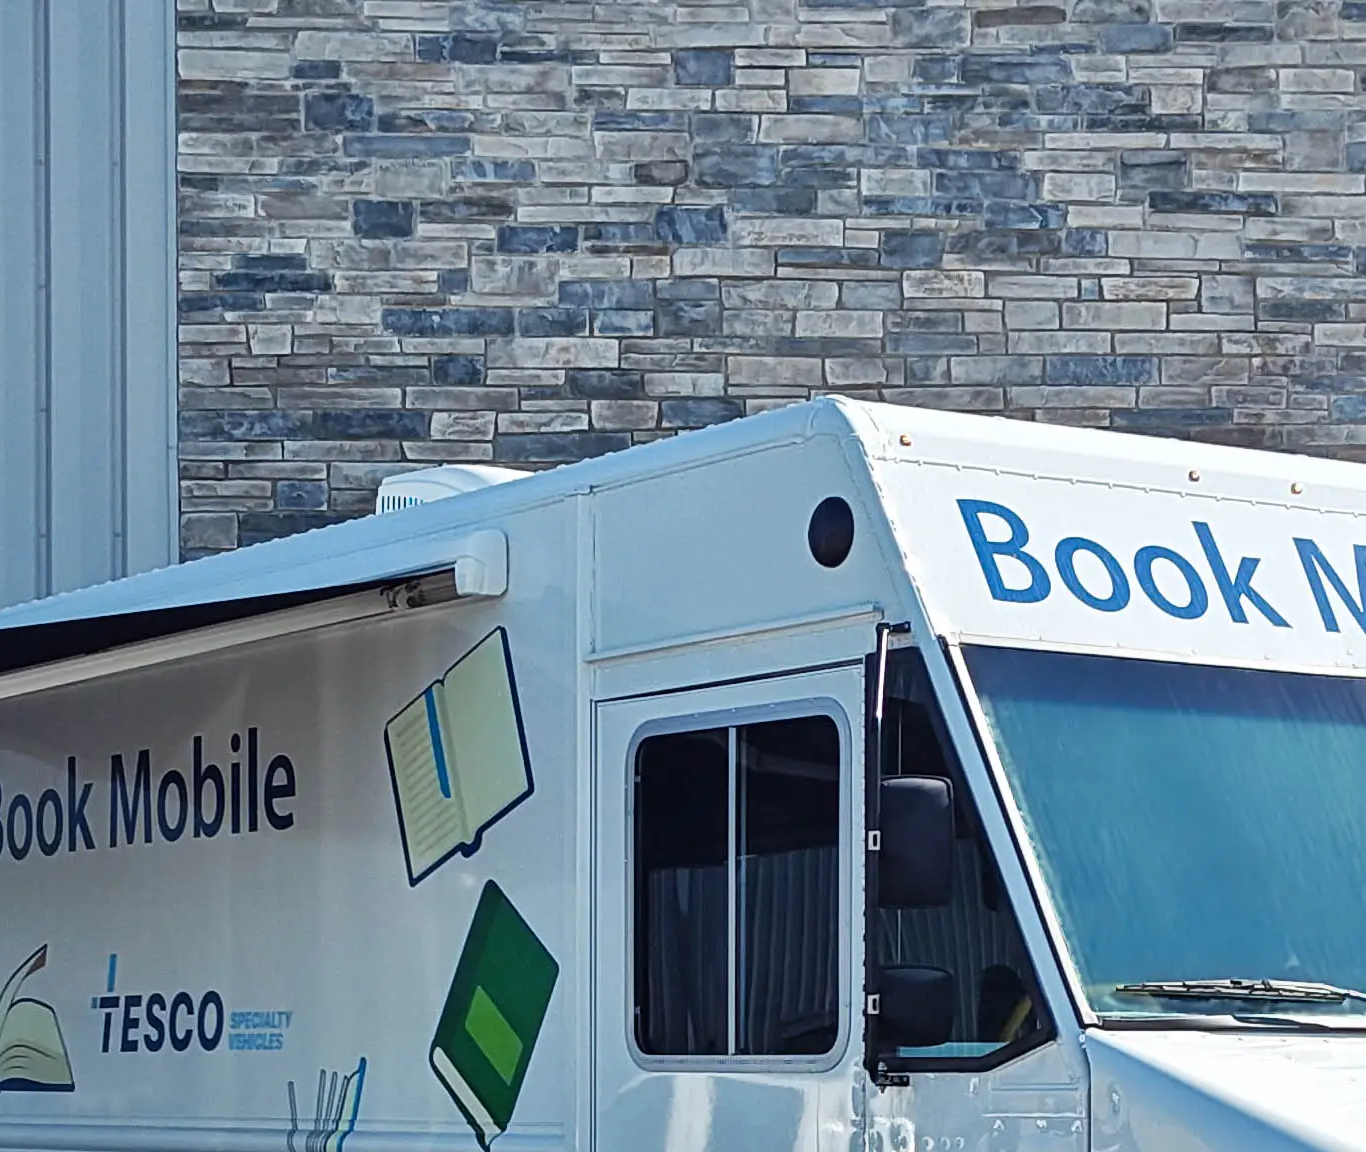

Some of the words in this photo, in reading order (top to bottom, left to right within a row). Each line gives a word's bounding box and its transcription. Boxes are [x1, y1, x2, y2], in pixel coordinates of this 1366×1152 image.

[956, 498, 1293, 629] Book
[109, 727, 296, 849] Mobile
[92, 989, 224, 1053] TESCO
[228, 1033, 284, 1050] VEHICLES
[230, 1011, 293, 1029] SPECIALTY
